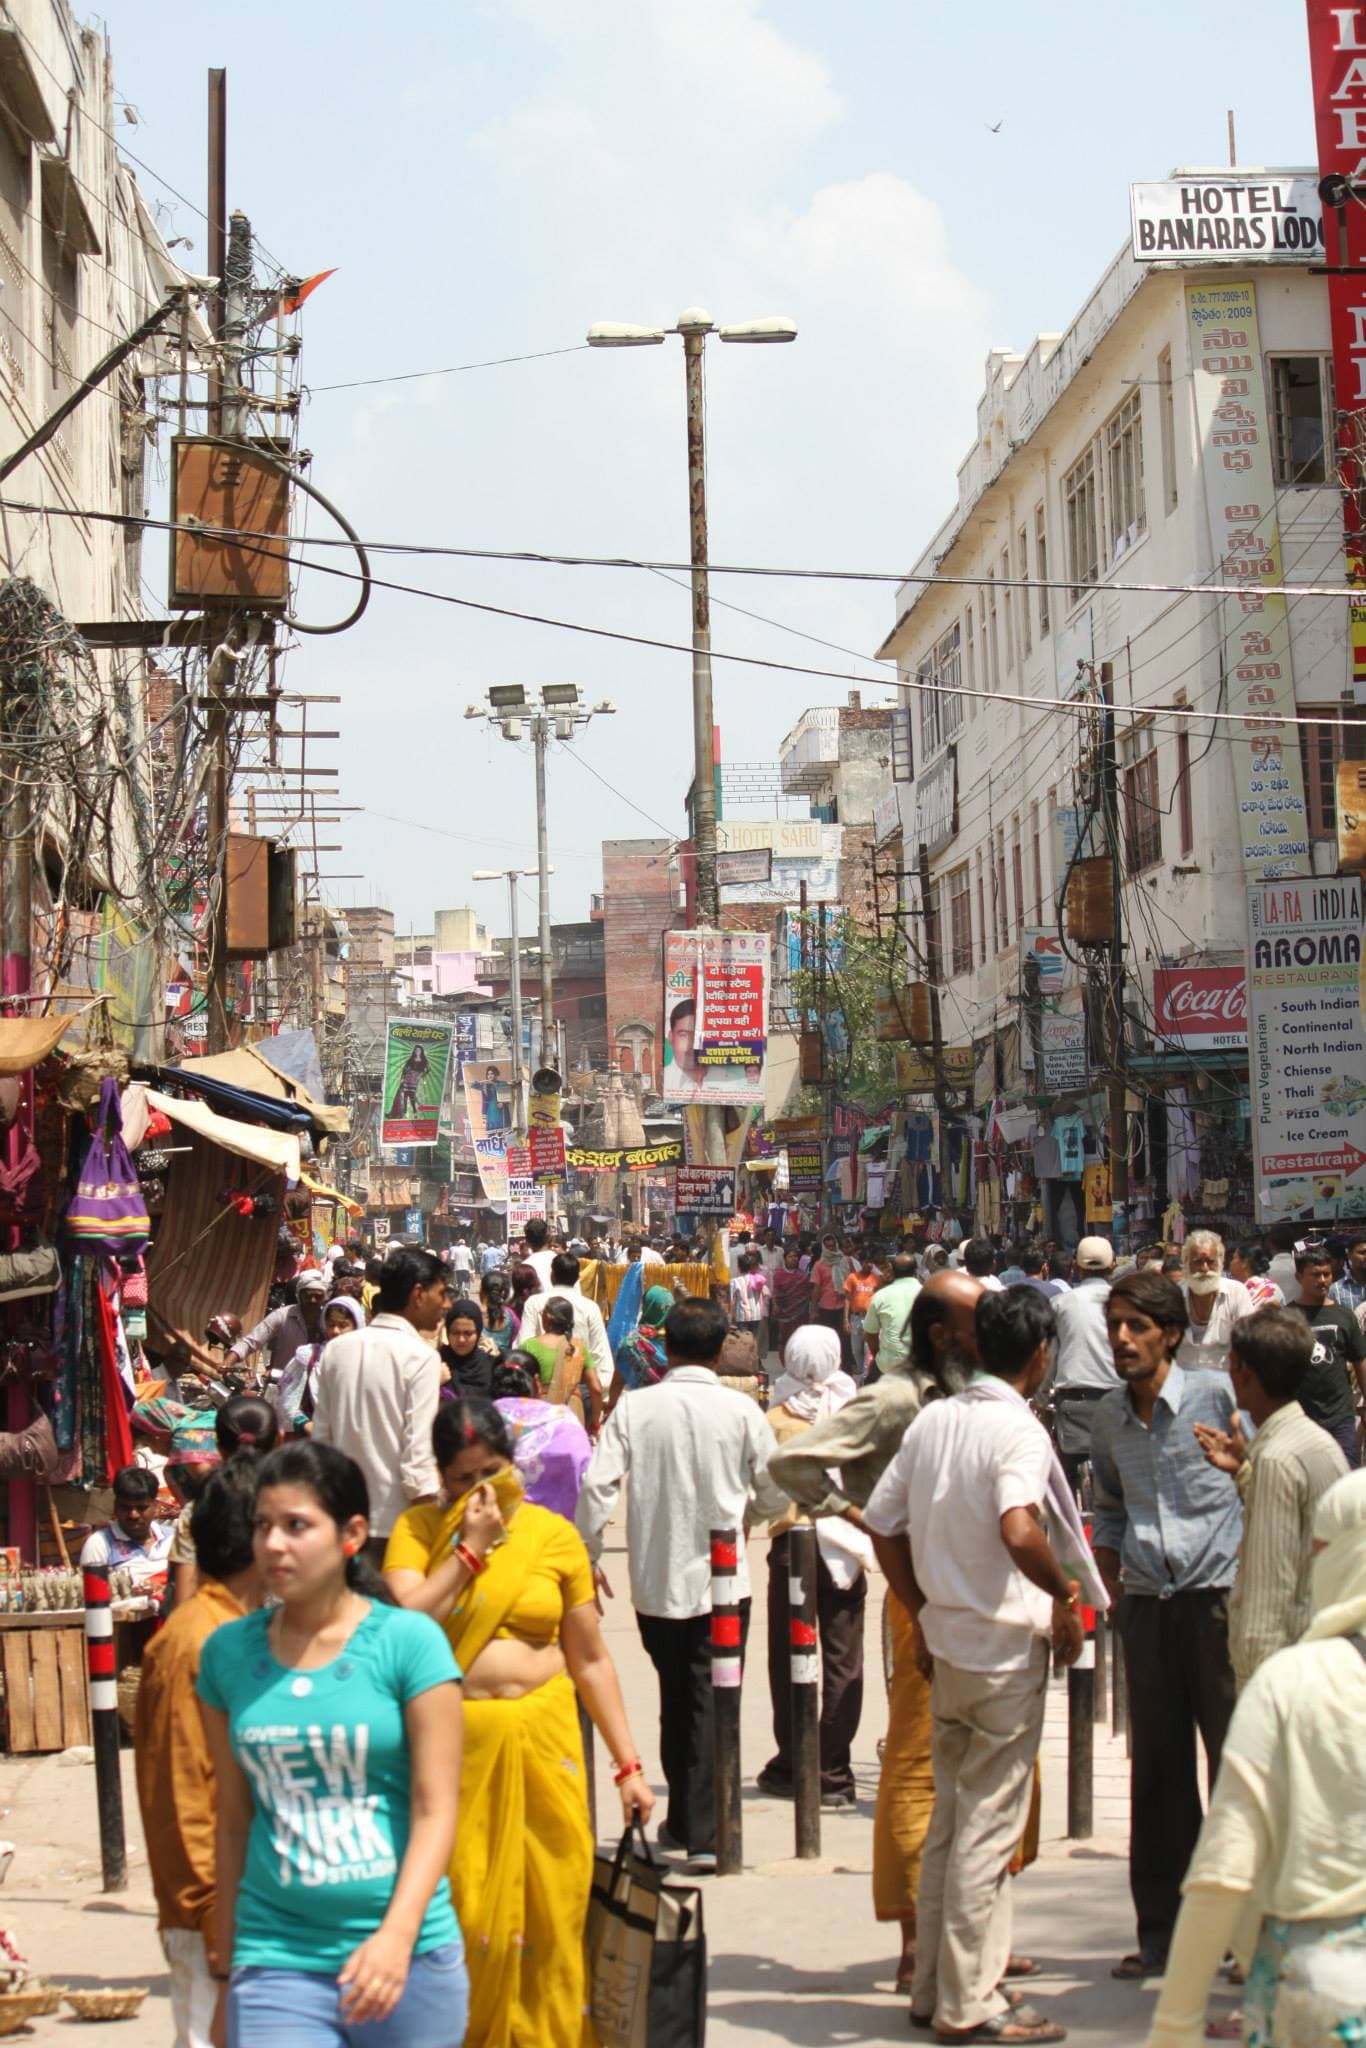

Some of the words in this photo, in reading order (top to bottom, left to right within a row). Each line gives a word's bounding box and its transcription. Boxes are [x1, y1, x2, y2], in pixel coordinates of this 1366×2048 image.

[1181, 186, 1297, 214] HOTEL
[1139, 216, 1267, 250] BANARAS
[1227, 306, 1252, 319] 2009
[733, 827, 774, 848] HOTEL
[781, 825, 818, 848] SAHU
[1255, 934, 1360, 969] AROMA
[1281, 1000, 1317, 1012] South
[1321, 998, 1360, 1010] Indian
[1282, 1018, 1353, 1034] Continental
[1213, 1035, 1241, 1045] HOTEL
[1283, 1042, 1319, 1055] North
[1324, 1040, 1363, 1053] Indian
[1257, 1014, 1271, 1088] Vegetarian
[1284, 1064, 1332, 1077] Chiense
[1285, 1085, 1314, 1098] Thali
[1260, 1092, 1271, 1124] Pure
[1287, 1109, 1320, 1120] Pizza
[1288, 1131, 1305, 1141] Ice
[1308, 1128, 1349, 1139] Cream
[238, 1724, 369, 1809] NEW
[270, 1790, 395, 1887] YORK
